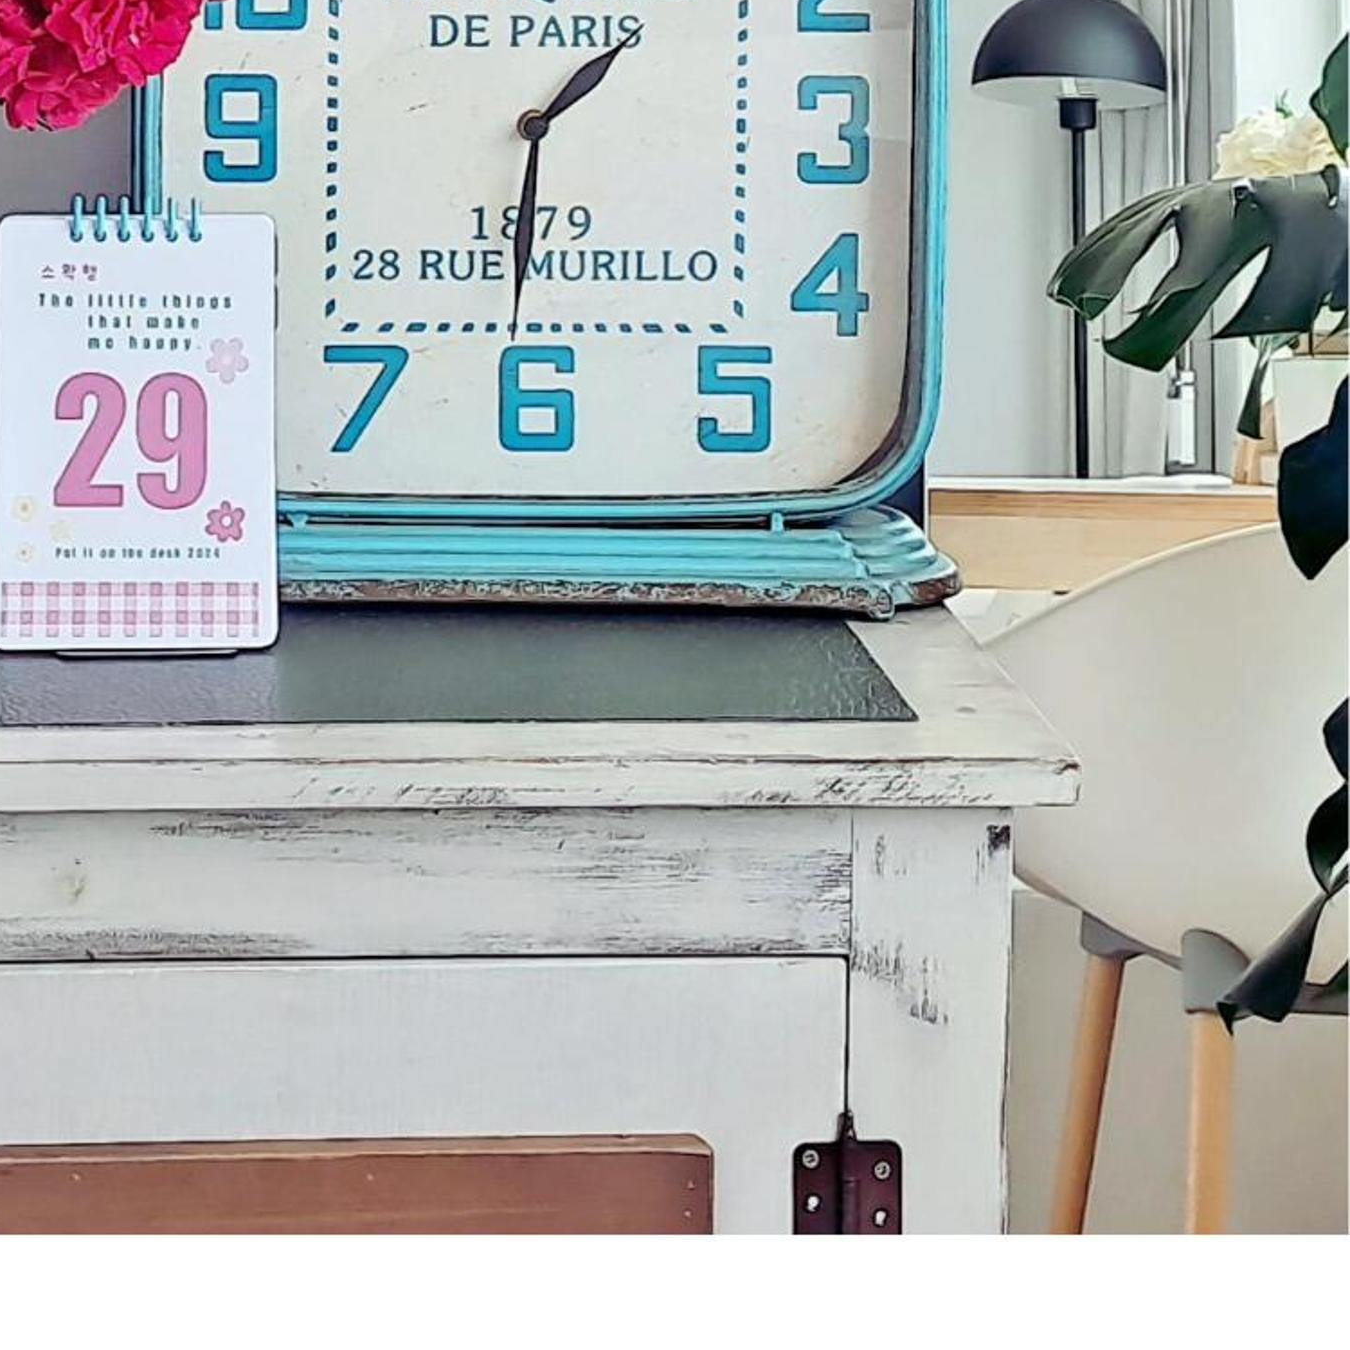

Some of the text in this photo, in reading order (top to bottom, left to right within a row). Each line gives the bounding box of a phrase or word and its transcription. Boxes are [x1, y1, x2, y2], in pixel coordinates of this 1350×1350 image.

[429, 14, 641, 49] DE PARIS
[203, 73, 278, 184] 9
[796, 74, 871, 185] 3
[352, 249, 718, 282] 28 RUE MURILLO
[470, 205, 592, 241] 1879
[38, 293, 232, 309] The little things
[87, 314, 200, 330] that make
[790, 232, 871, 338] 4
[87, 337, 115, 350] me
[53, 371, 208, 511] 29
[323, 344, 410, 453] 7
[498, 344, 575, 453] 6
[696, 344, 773, 454] 5
